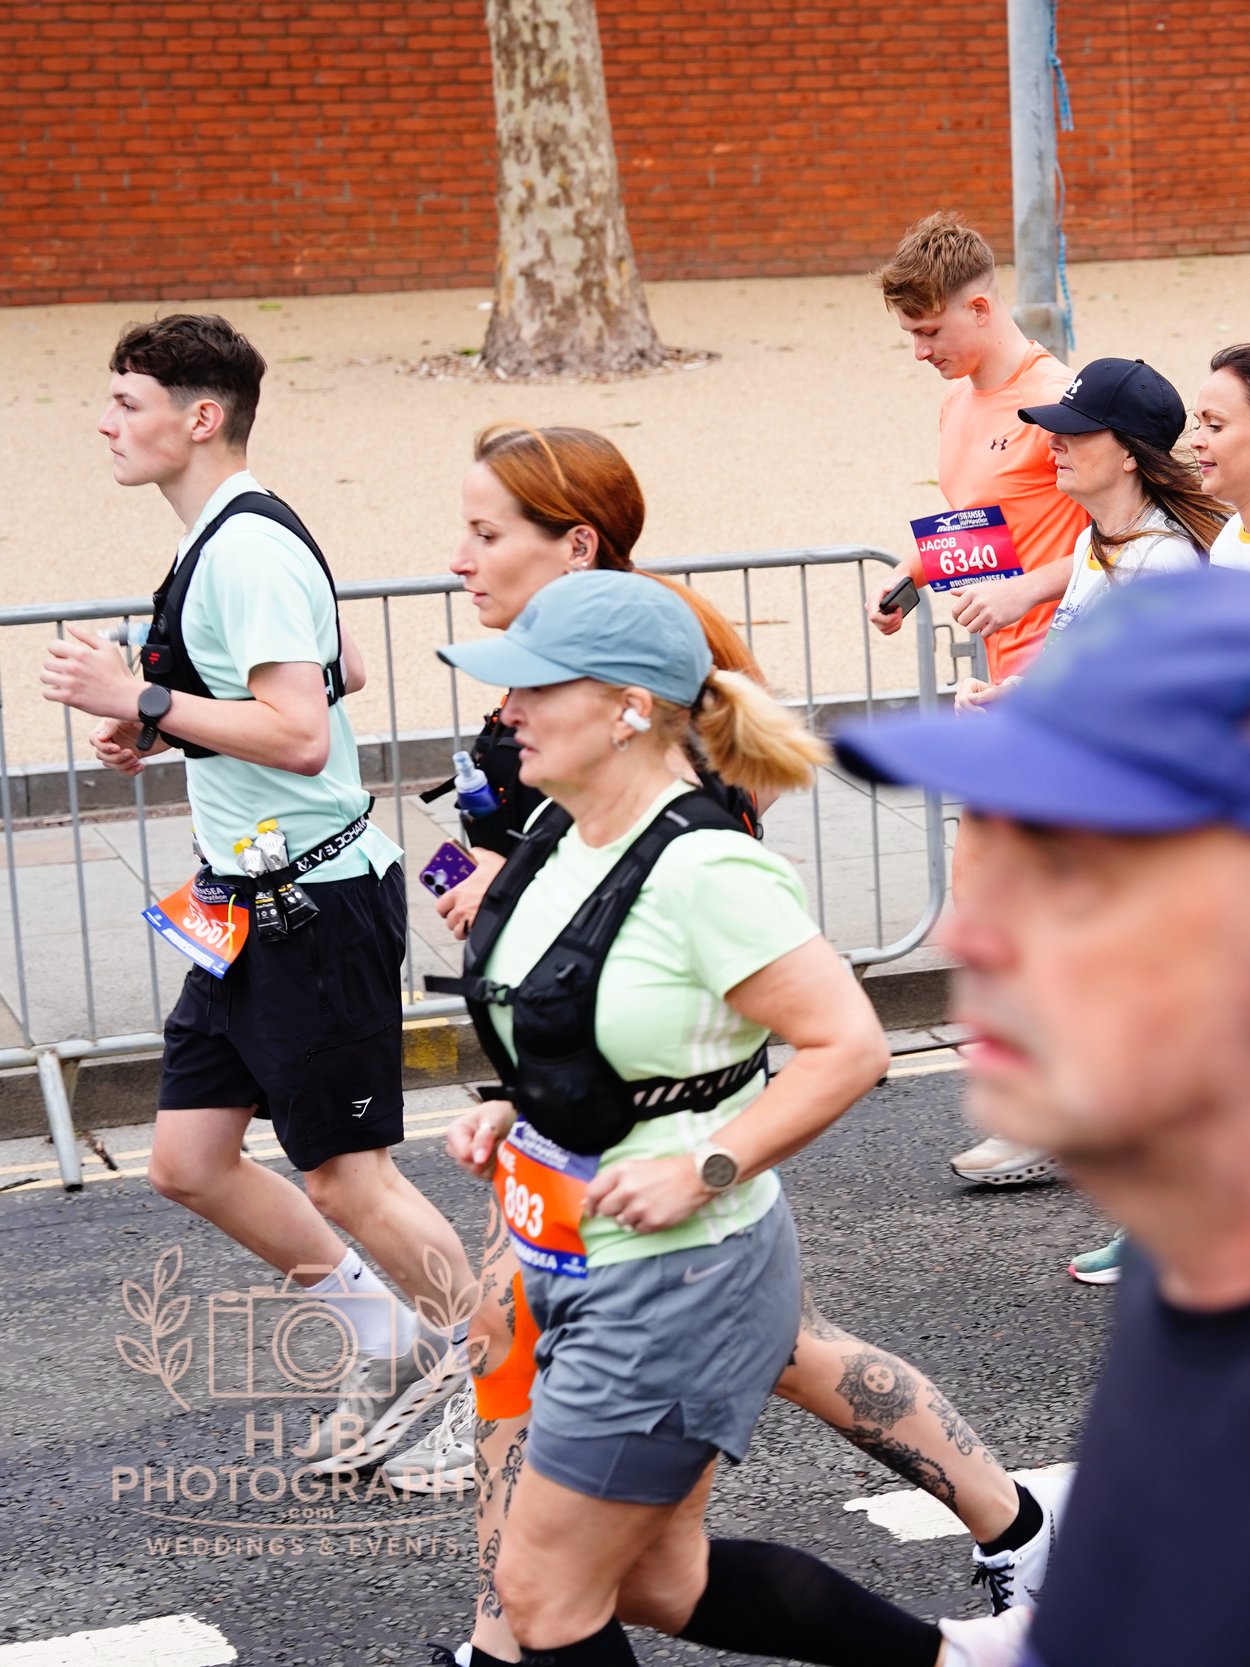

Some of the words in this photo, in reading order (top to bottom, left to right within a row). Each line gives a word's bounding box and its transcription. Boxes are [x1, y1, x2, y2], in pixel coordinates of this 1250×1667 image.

[959, 509, 987, 520] SWANSEA
[920, 537, 957, 552] JACOB
[940, 544, 998, 576] 6340
[504, 1175, 544, 1238] 893
